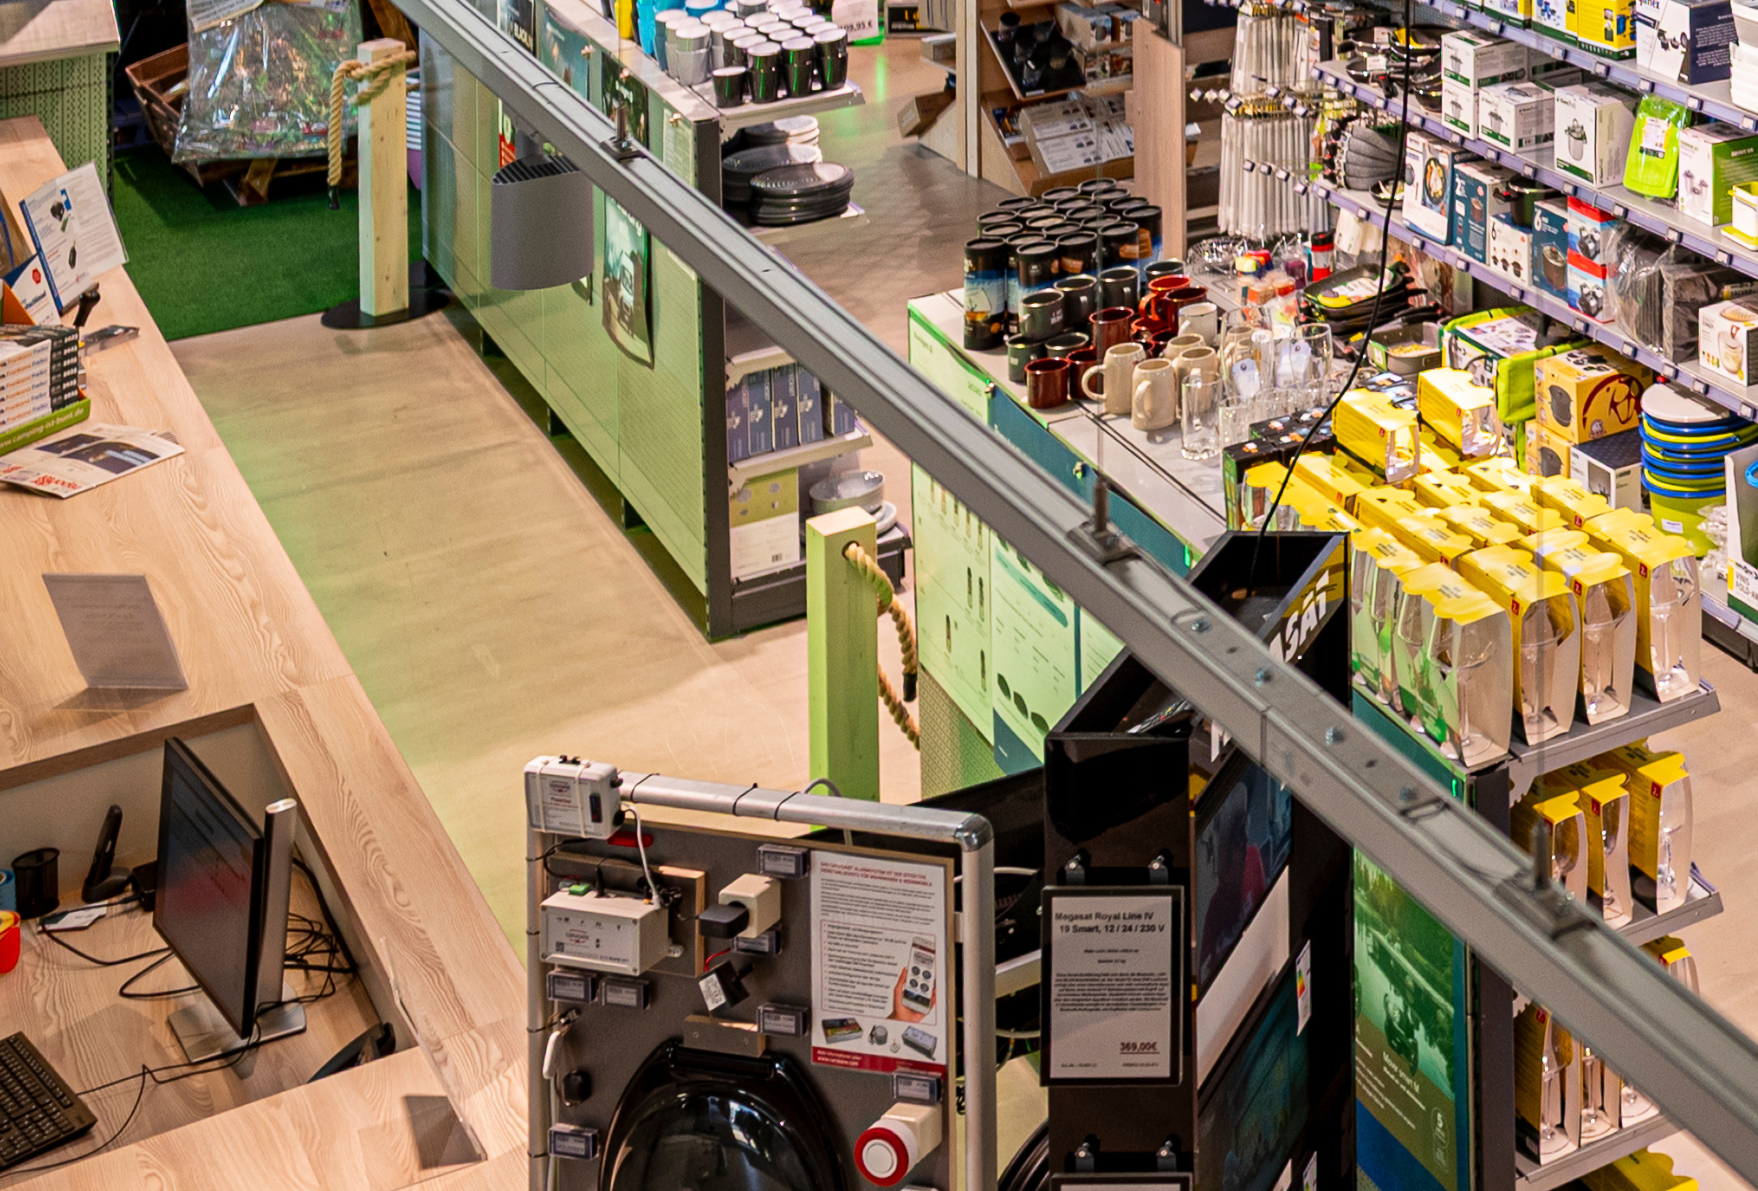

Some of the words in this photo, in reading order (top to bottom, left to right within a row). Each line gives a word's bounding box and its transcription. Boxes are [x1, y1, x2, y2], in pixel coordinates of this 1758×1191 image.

[1267, 570, 1330, 664] ASAT
[1055, 911, 1094, 923] Megasat
[1095, 912, 1121, 923] Royal
[1122, 911, 1143, 921] Line
[1143, 911, 1154, 921] IV
[1059, 924, 1070, 933] 19
[1071, 924, 1102, 934] Smart,
[1104, 924, 1114, 933] 12
[1121, 924, 1133, 933] 24
[1139, 924, 1156, 933] 230
[1156, 924, 1165, 932] V
[1119, 1041, 1158, 1053] 369,00€
[1436, 1112, 1443, 1128] 5
